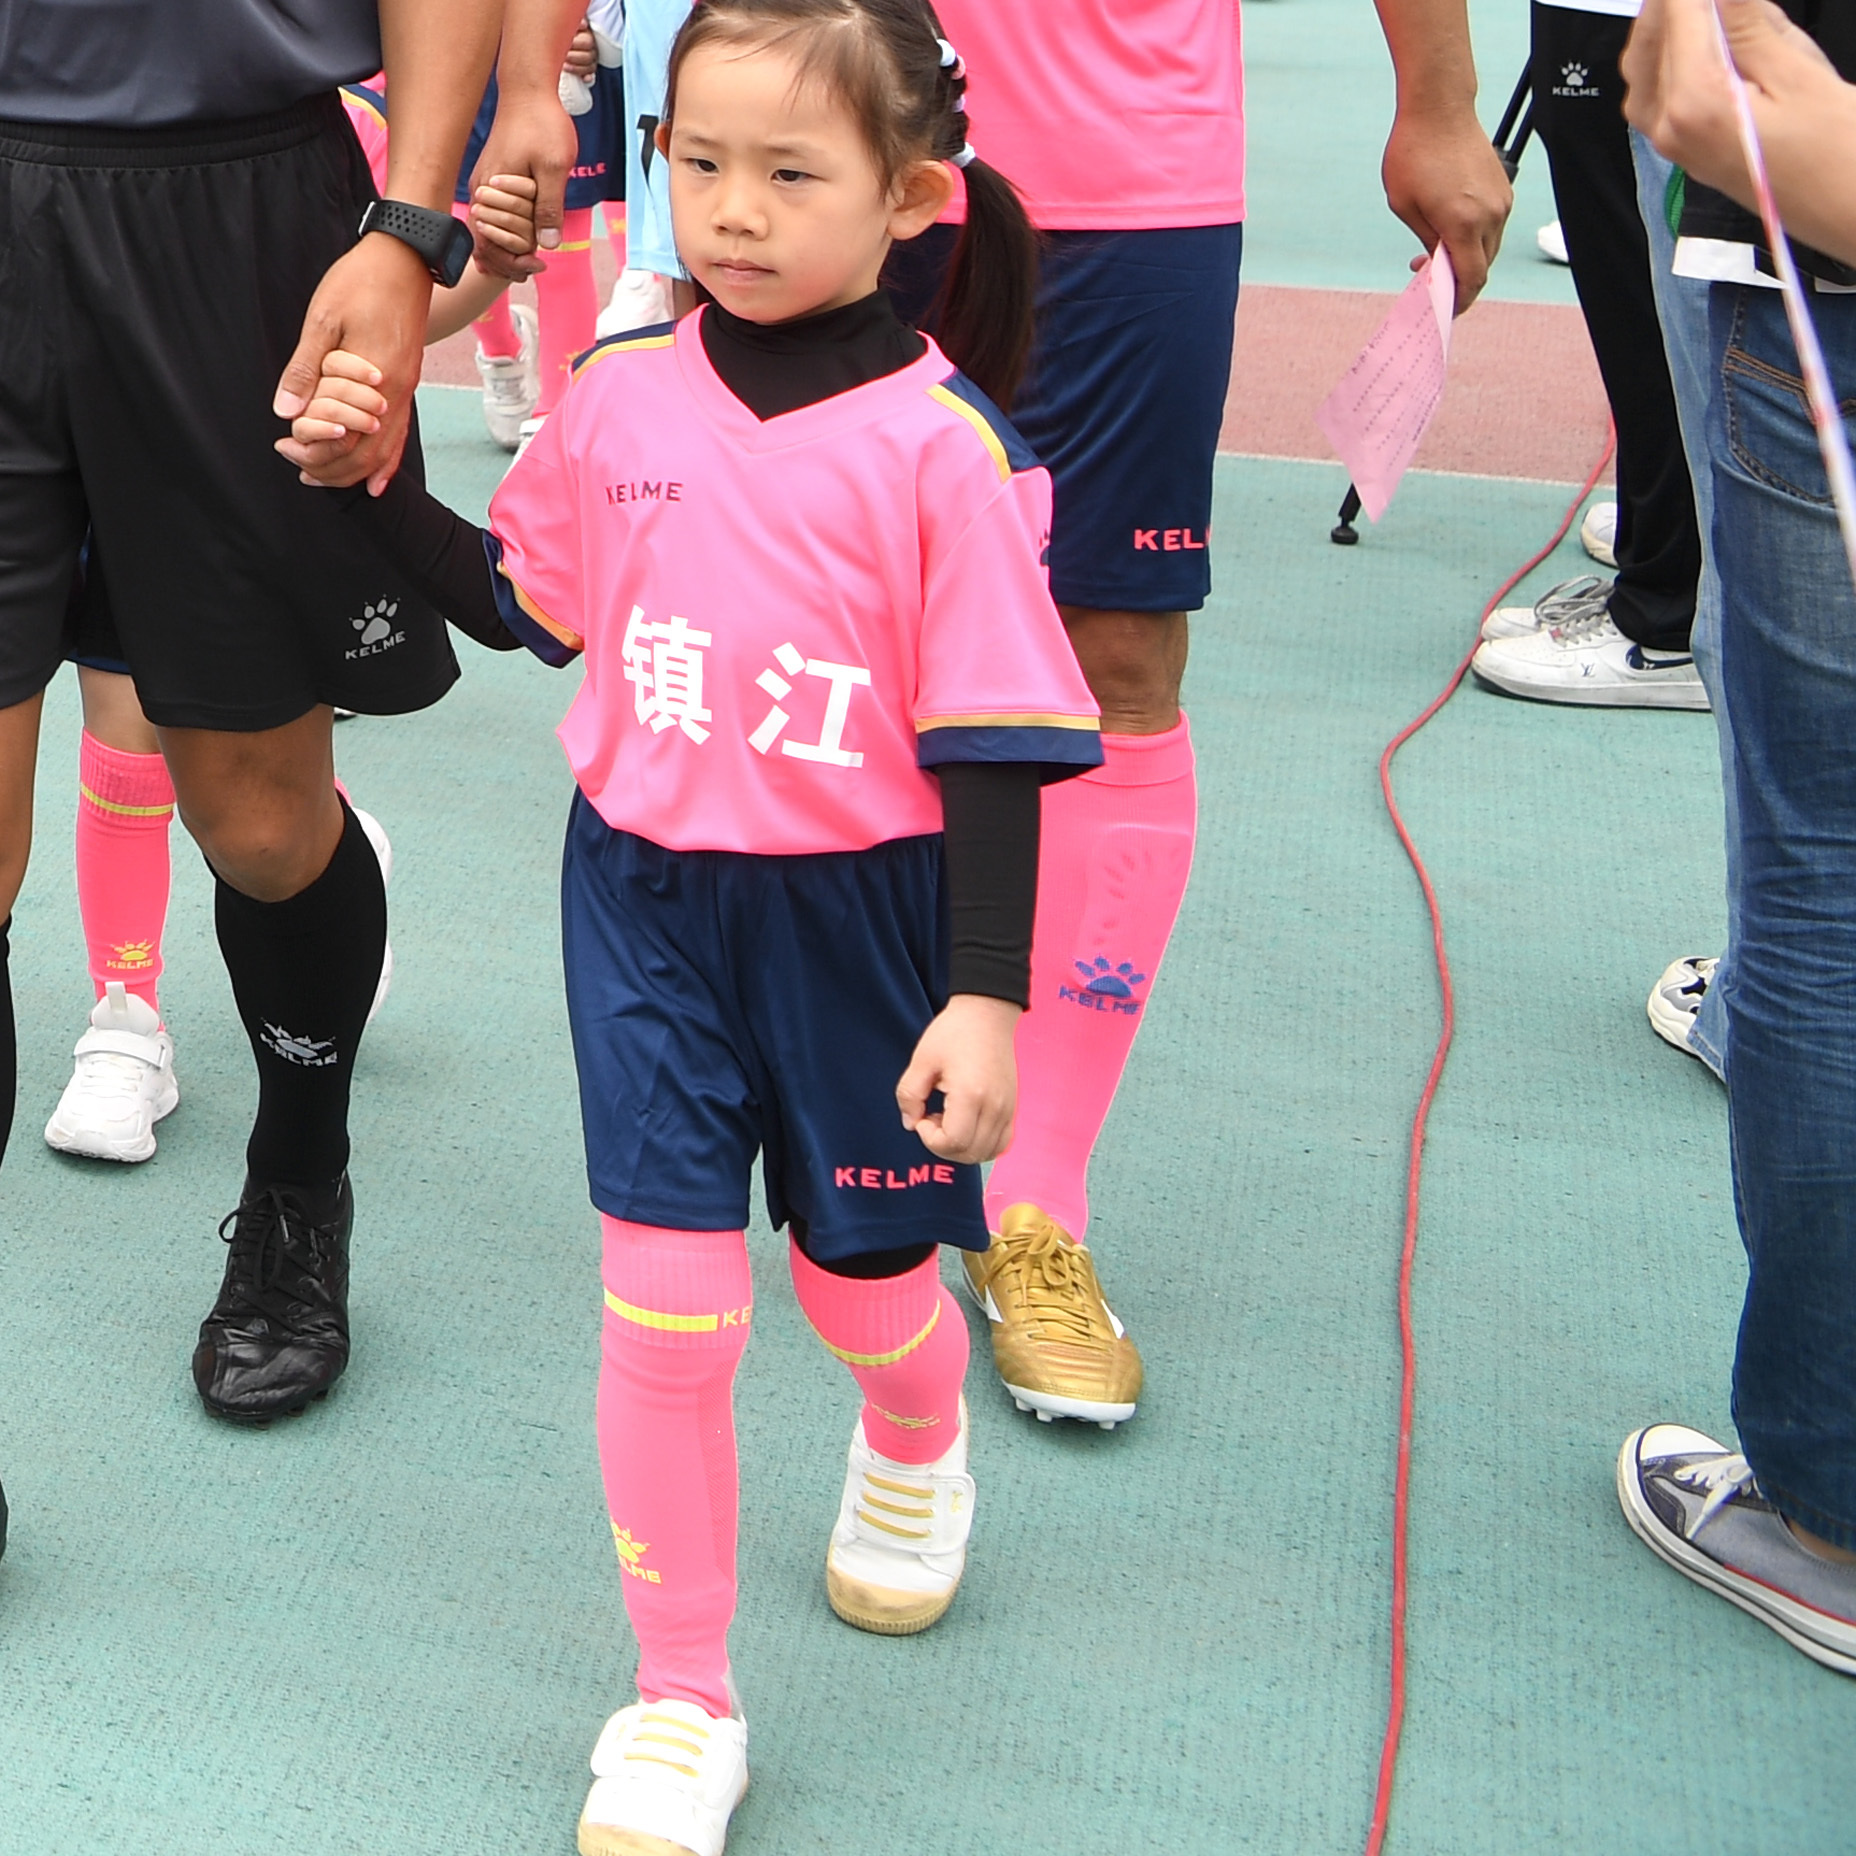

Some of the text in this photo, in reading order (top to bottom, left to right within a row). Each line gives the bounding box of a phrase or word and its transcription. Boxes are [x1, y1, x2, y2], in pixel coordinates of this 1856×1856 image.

[1551, 86, 1600, 98] KELME
[606, 480, 684, 505] KELME
[1133, 527, 1211, 552] KEL
[344, 630, 407, 662] KELME
[621, 604, 871, 768] 镇江
[106, 956, 155, 970] KELME
[1059, 985, 1141, 1015] KELME
[834, 1164, 955, 1190] KELME
